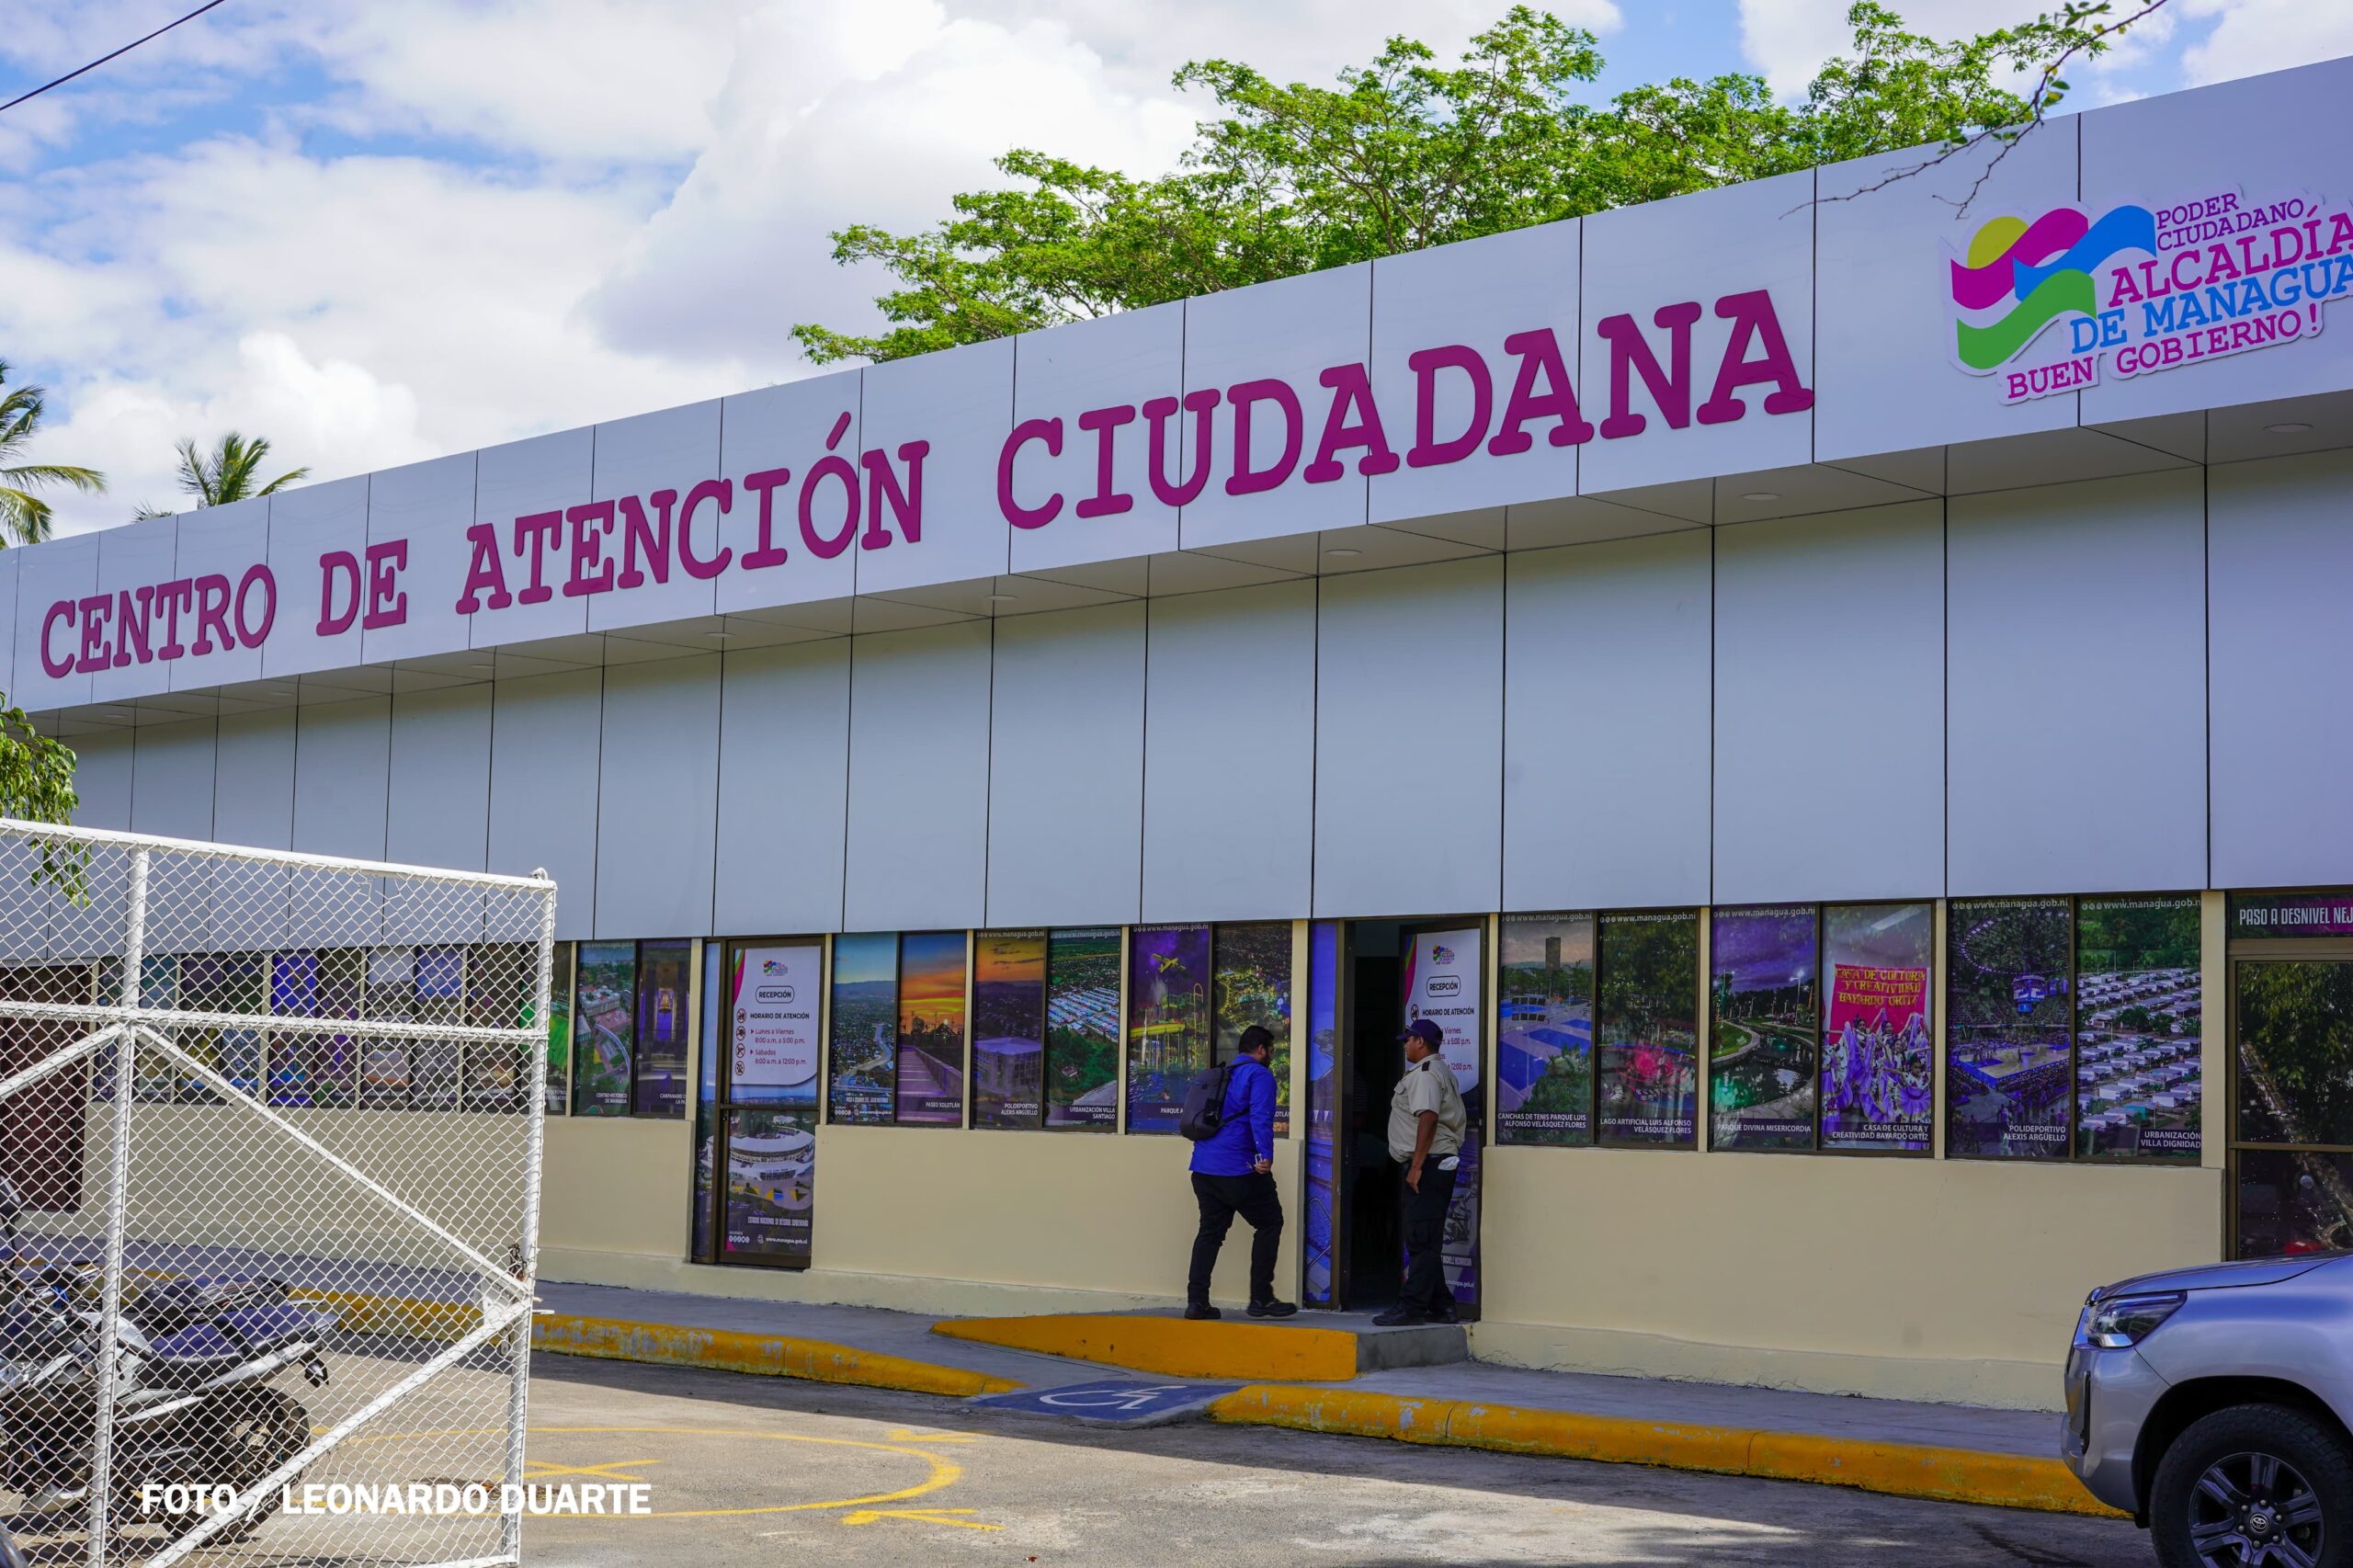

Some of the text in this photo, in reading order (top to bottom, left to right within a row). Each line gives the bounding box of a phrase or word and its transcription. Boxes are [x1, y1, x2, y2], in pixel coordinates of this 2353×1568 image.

[2155, 192, 2239, 230] PODER
[2155, 198, 2304, 251] CIUDADANO
[2108, 205, 2353, 308] ALCALDÍA
[2070, 253, 2353, 355] DE MANAGUA
[2006, 302, 2318, 399] BUEN GOBIERNO!
[40, 289, 1815, 678] CENTRO DE ATENCIÓN CIUDADANA
[1973, 898, 2069, 910] www.managua.gob.ni
[1731, 906, 1816, 918] www.managua.gob.ni
[2239, 908, 2268, 926] PASO
[2270, 908, 2278, 925] A
[2281, 907, 2330, 925] DESNIVEL
[1517, 912, 1593, 923] www.managua.gob.ni
[1617, 911, 1697, 924] www.managua.gob.ni
[1147, 922, 1209, 934] www.managua.gob.ni
[1864, 970, 1876, 980] DE
[1429, 982, 1459, 992] RECEPCIÓN
[758, 989, 791, 998] RECEPCIÓN
[783, 1011, 810, 1019] ATENCIÓN
[1451, 1006, 1474, 1016] ATENCIÓN
[1497, 1112, 1525, 1120] CANCHAS
[1551, 1114, 1573, 1122] PARQUE
[1531, 1119, 1564, 1129] VELÁSQUEZ
[1565, 1120, 1586, 1129] FLORES
[1617, 1118, 1648, 1126] ARTIFICIAL
[1662, 1119, 1692, 1127] ALFONSO
[1717, 1123, 1812, 1132] PARQUE DIVINA MISERICORDIA
[1863, 1123, 1881, 1131] CASA
[1893, 1124, 1923, 1132] CULTURA
[1923, 1124, 1928, 1132] Y
[1634, 1125, 1692, 1134] VELÁSQUEZ FLORES
[2009, 1125, 2066, 1133] POLIDEPORTIVO
[1876, 1131, 1908, 1140] BAYARDO
[2003, 1132, 2066, 1142] ALEXIS ARGÜELLO
[2144, 1130, 2201, 1140] URBANIZACIÓN
[2140, 1139, 2201, 1148] VILLA DIGNIDAD
